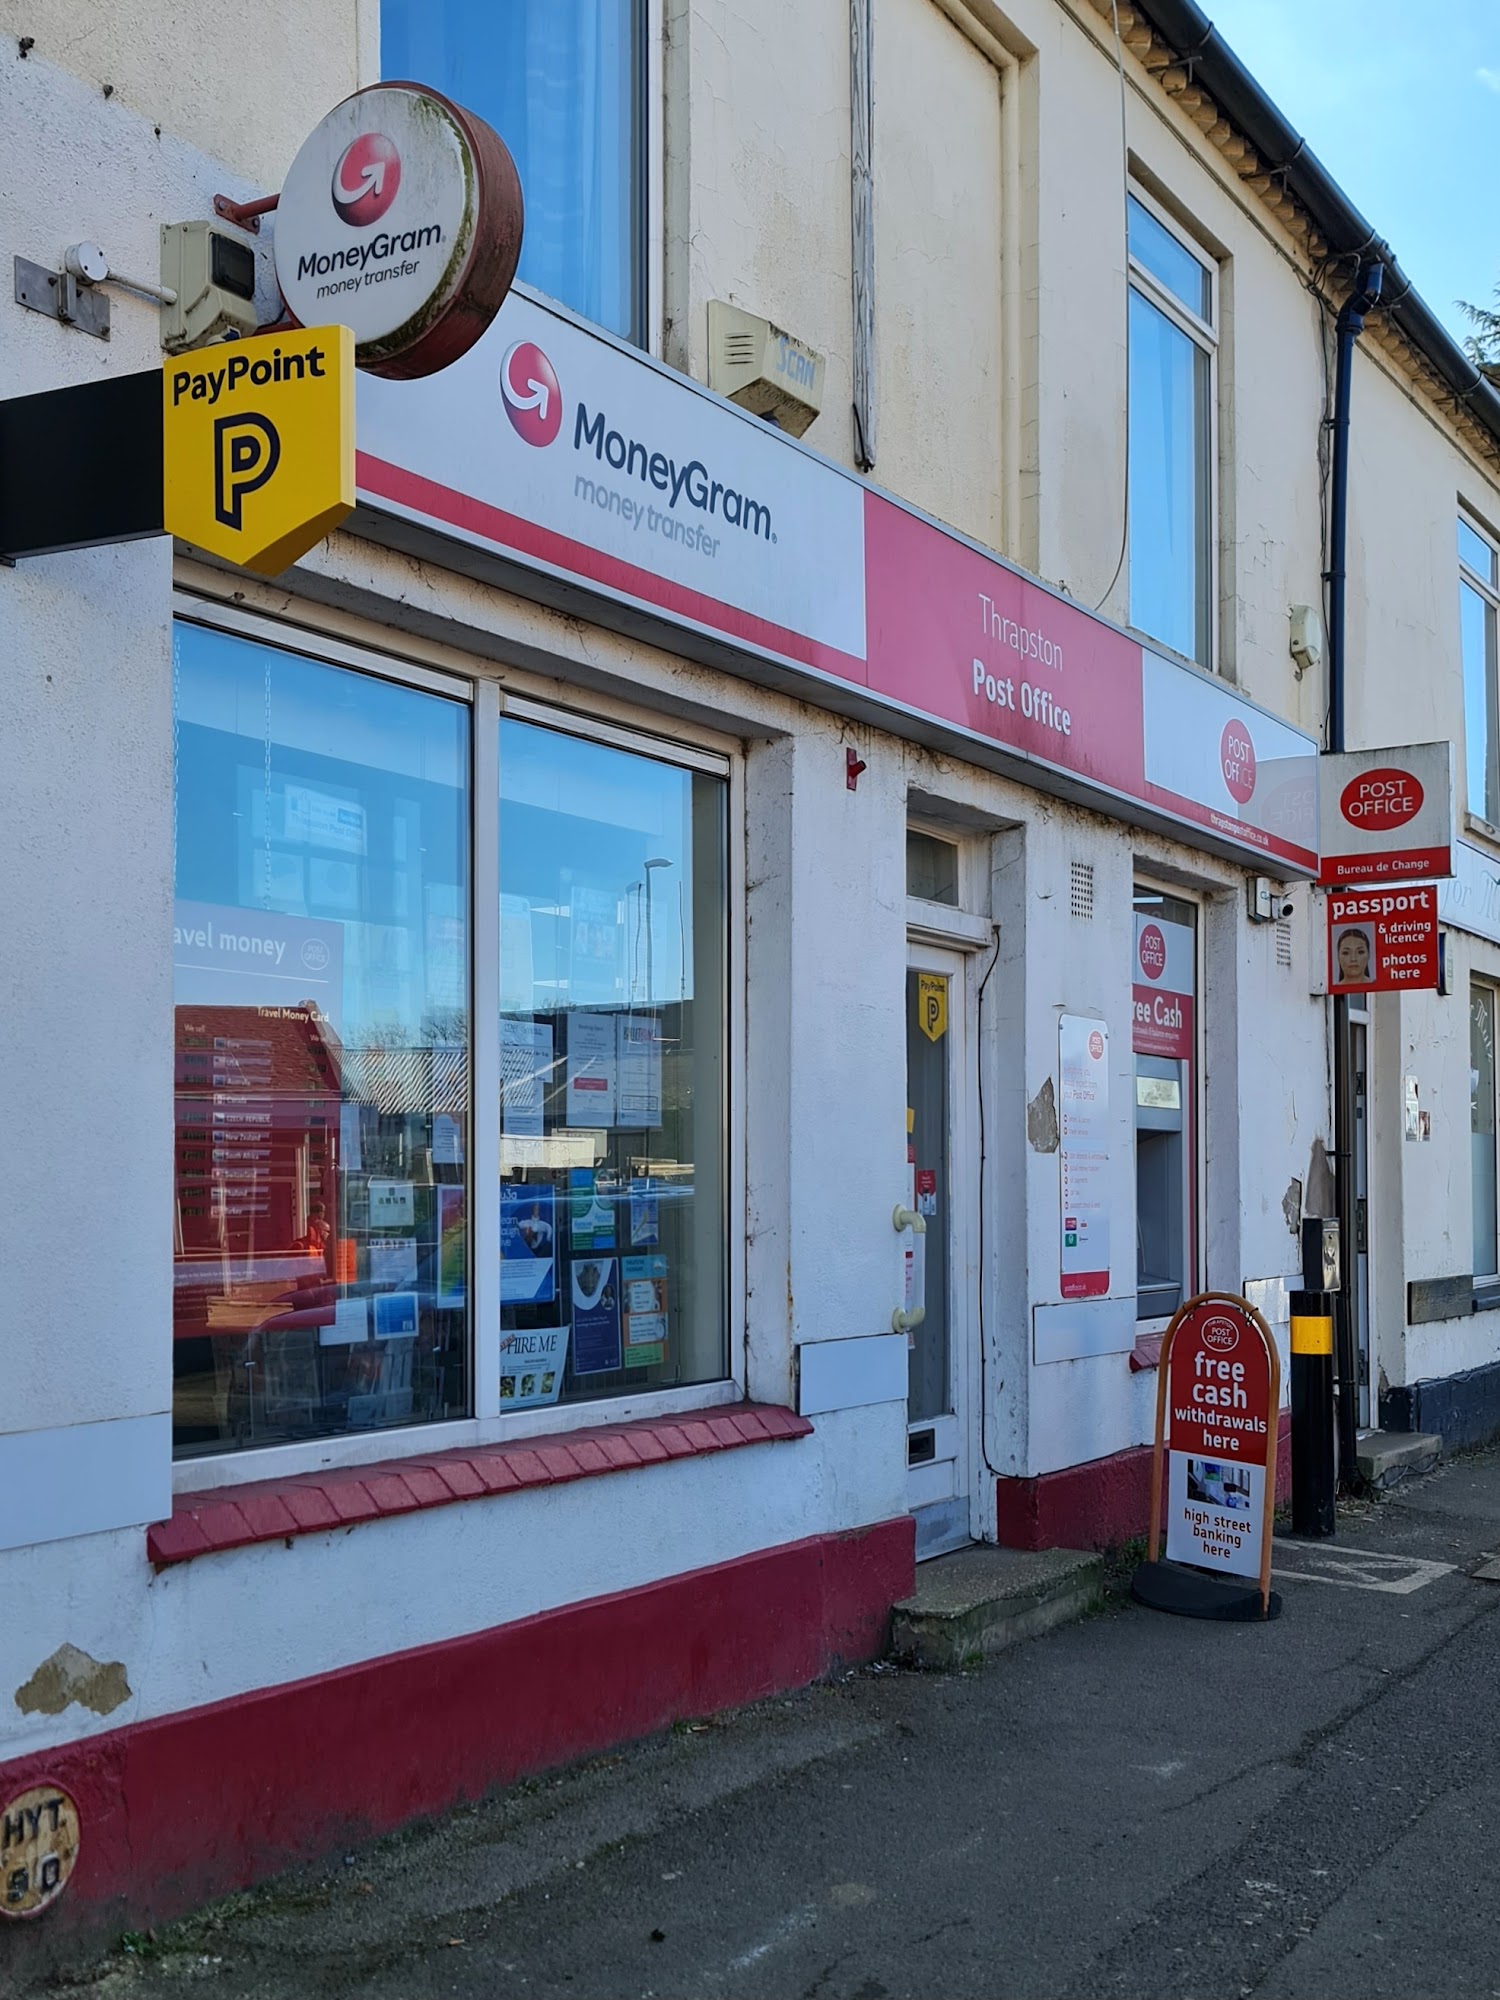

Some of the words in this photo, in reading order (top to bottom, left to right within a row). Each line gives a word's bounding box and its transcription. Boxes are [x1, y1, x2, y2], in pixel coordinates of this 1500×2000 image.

[297, 224, 441, 280] MoneyGram
[316, 276, 362, 299] money
[364, 259, 420, 286] transfer
[173, 346, 326, 406] PayPoint
[573, 402, 771, 540] MoneyGram
[574, 474, 644, 531] money
[646, 504, 720, 558] transfer
[978, 593, 1063, 672] Thrapston
[972, 658, 1015, 711] Post
[1020, 681, 1071, 736] Office
[1228, 735, 1250, 764] POST
[1359, 780, 1407, 799] POST
[1348, 797, 1414, 817] OFFICE
[1337, 864, 1374, 875] Bureau
[1376, 861, 1389, 873] de
[1391, 858, 1430, 873] Change
[1332, 891, 1430, 920] passport
[1378, 923, 1387, 934] &
[1390, 920, 1431, 935] driving
[1384, 932, 1425, 945] licence
[174, 921, 213, 949] avel
[219, 932, 286, 964] money
[1145, 935, 1161, 949] POST
[1141, 950, 1163, 967] OFFICE
[1382, 953, 1427, 967] photos
[1390, 967, 1420, 980] here
[257, 1007, 281, 1018] Travel
[283, 1008, 309, 1023] Money
[310, 1011, 329, 1022] Card
[1132, 1001, 1151, 1023] ree
[1154, 996, 1183, 1029] Cash
[501, 1215, 518, 1225] earn
[501, 1226, 520, 1238] augh
[1207, 1334, 1233, 1345] OFFICE
[1211, 1327, 1231, 1336] POST
[507, 1335, 537, 1354] HIRE
[538, 1335, 558, 1352] ME
[1194, 1351, 1245, 1382] free
[1192, 1382, 1247, 1409] cash
[1174, 1405, 1267, 1433] withdrawals
[1203, 1428, 1239, 1451] here
[1184, 1507, 1209, 1525] high
[1214, 1516, 1251, 1533] street
[1193, 1524, 1241, 1548] banking
[1203, 1541, 1231, 1558] here
